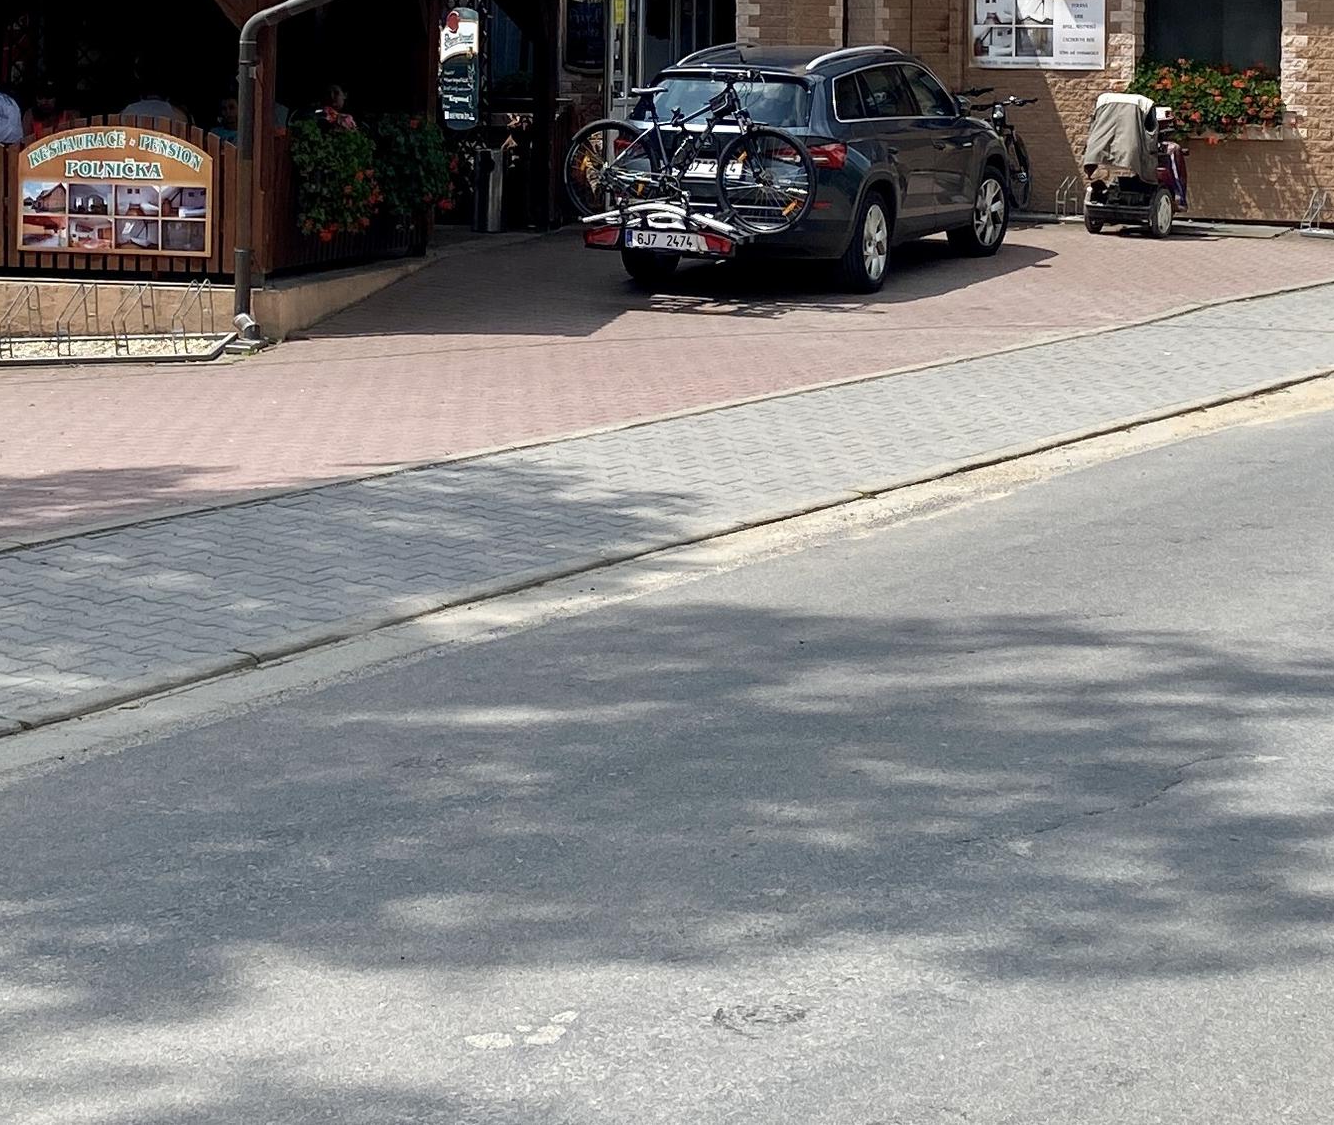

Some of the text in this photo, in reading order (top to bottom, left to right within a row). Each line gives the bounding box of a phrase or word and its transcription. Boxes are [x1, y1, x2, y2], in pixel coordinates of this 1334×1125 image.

[27, 131, 204, 172] RESTAURACE PENSION
[65, 158, 164, 180] POLNIČKA
[637, 233, 693, 248] 6J7 2474
